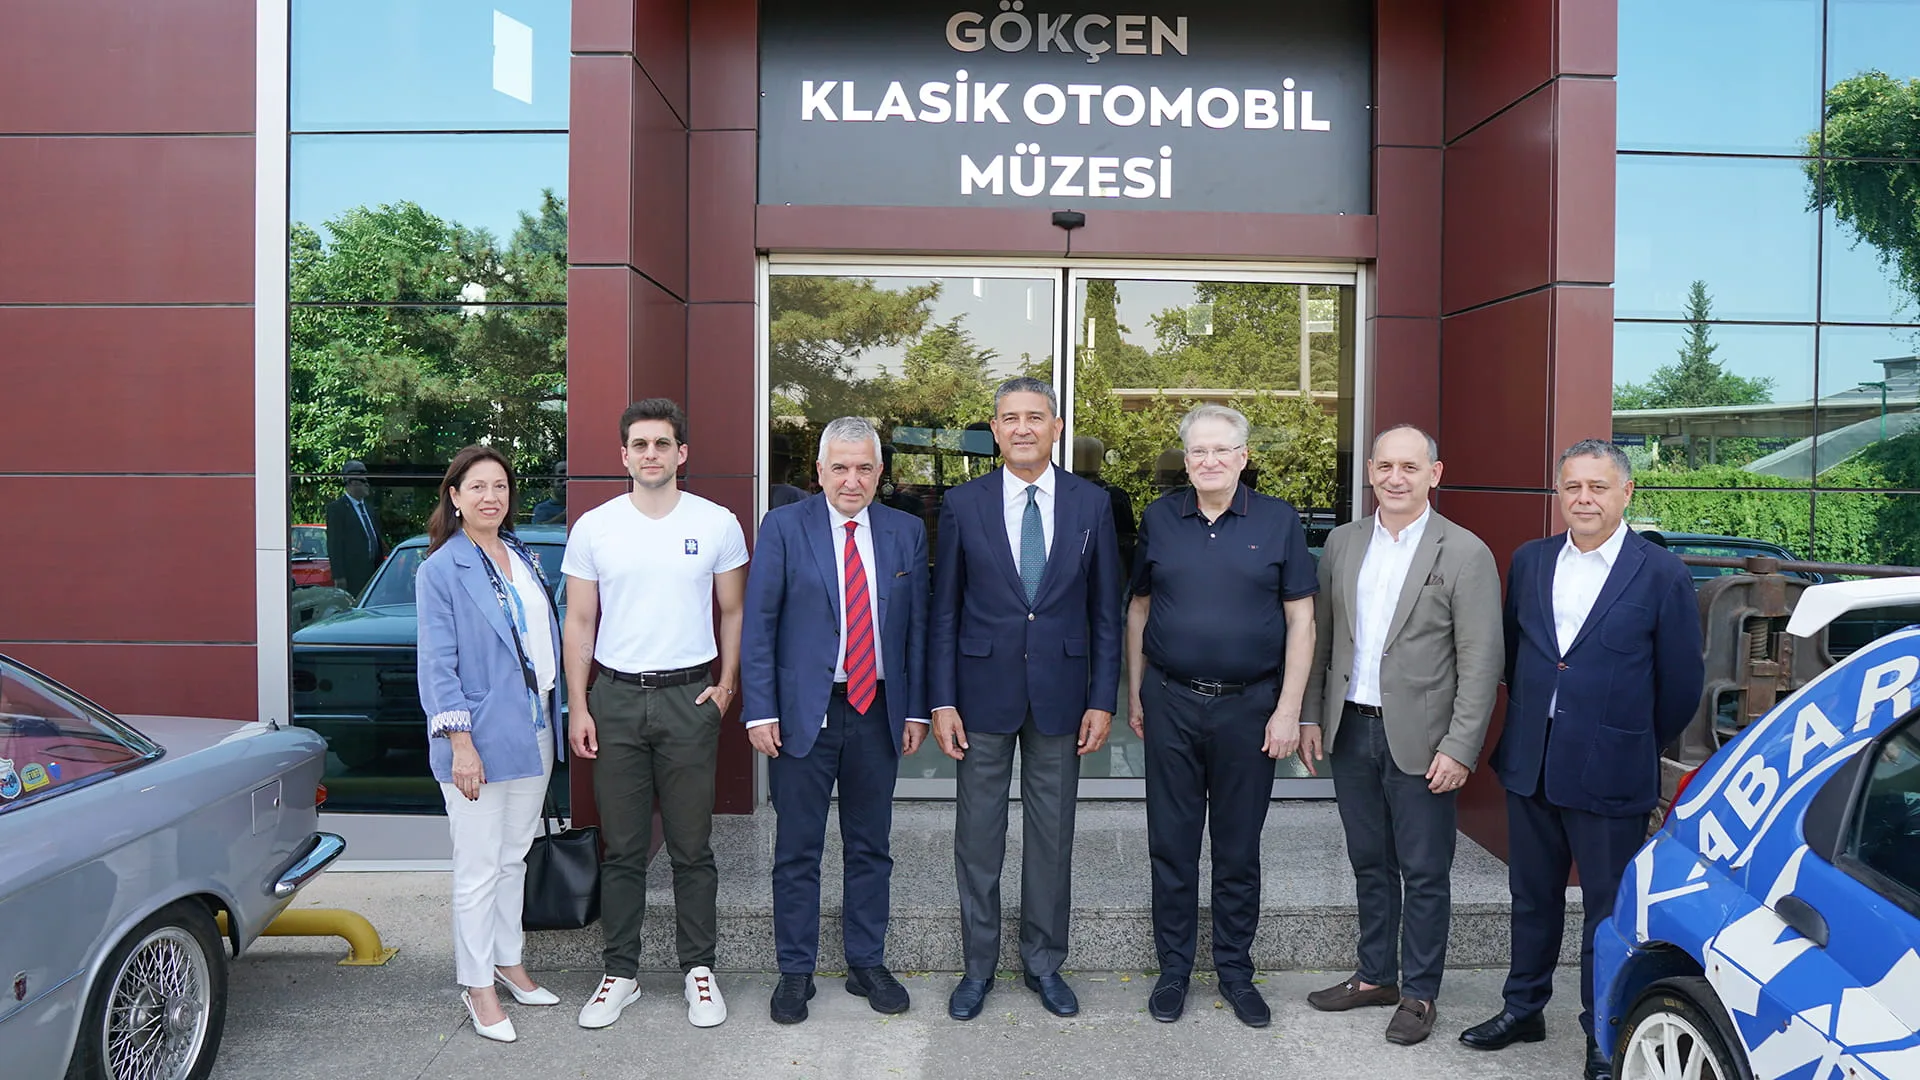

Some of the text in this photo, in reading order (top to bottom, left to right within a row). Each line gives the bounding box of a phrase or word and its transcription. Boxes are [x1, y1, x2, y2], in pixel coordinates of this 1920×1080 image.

[945, 0, 1188, 63] GÖKÇEN
[801, 69, 1330, 131] KLASİK OTOMOBİL
[960, 142, 1172, 199] MÜZESİ
